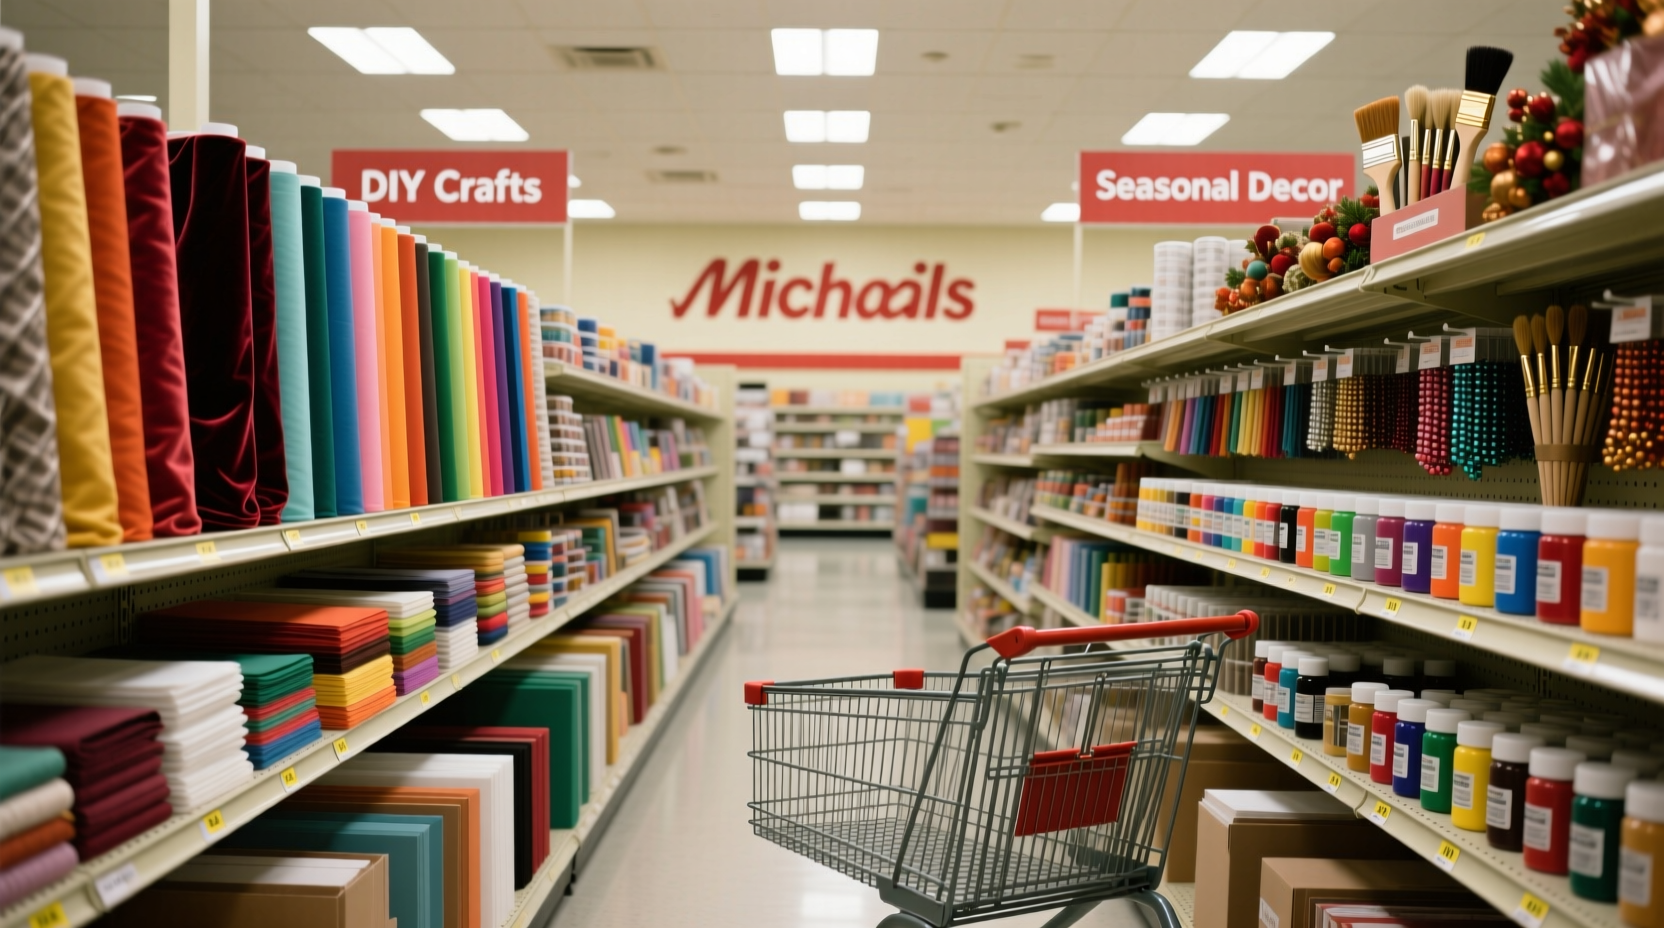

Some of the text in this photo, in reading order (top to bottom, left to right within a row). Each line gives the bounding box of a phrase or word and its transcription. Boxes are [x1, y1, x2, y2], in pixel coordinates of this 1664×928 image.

[361, 168, 542, 204] DIY Crafts
[1096, 169, 1344, 202] Seasonal Decor
